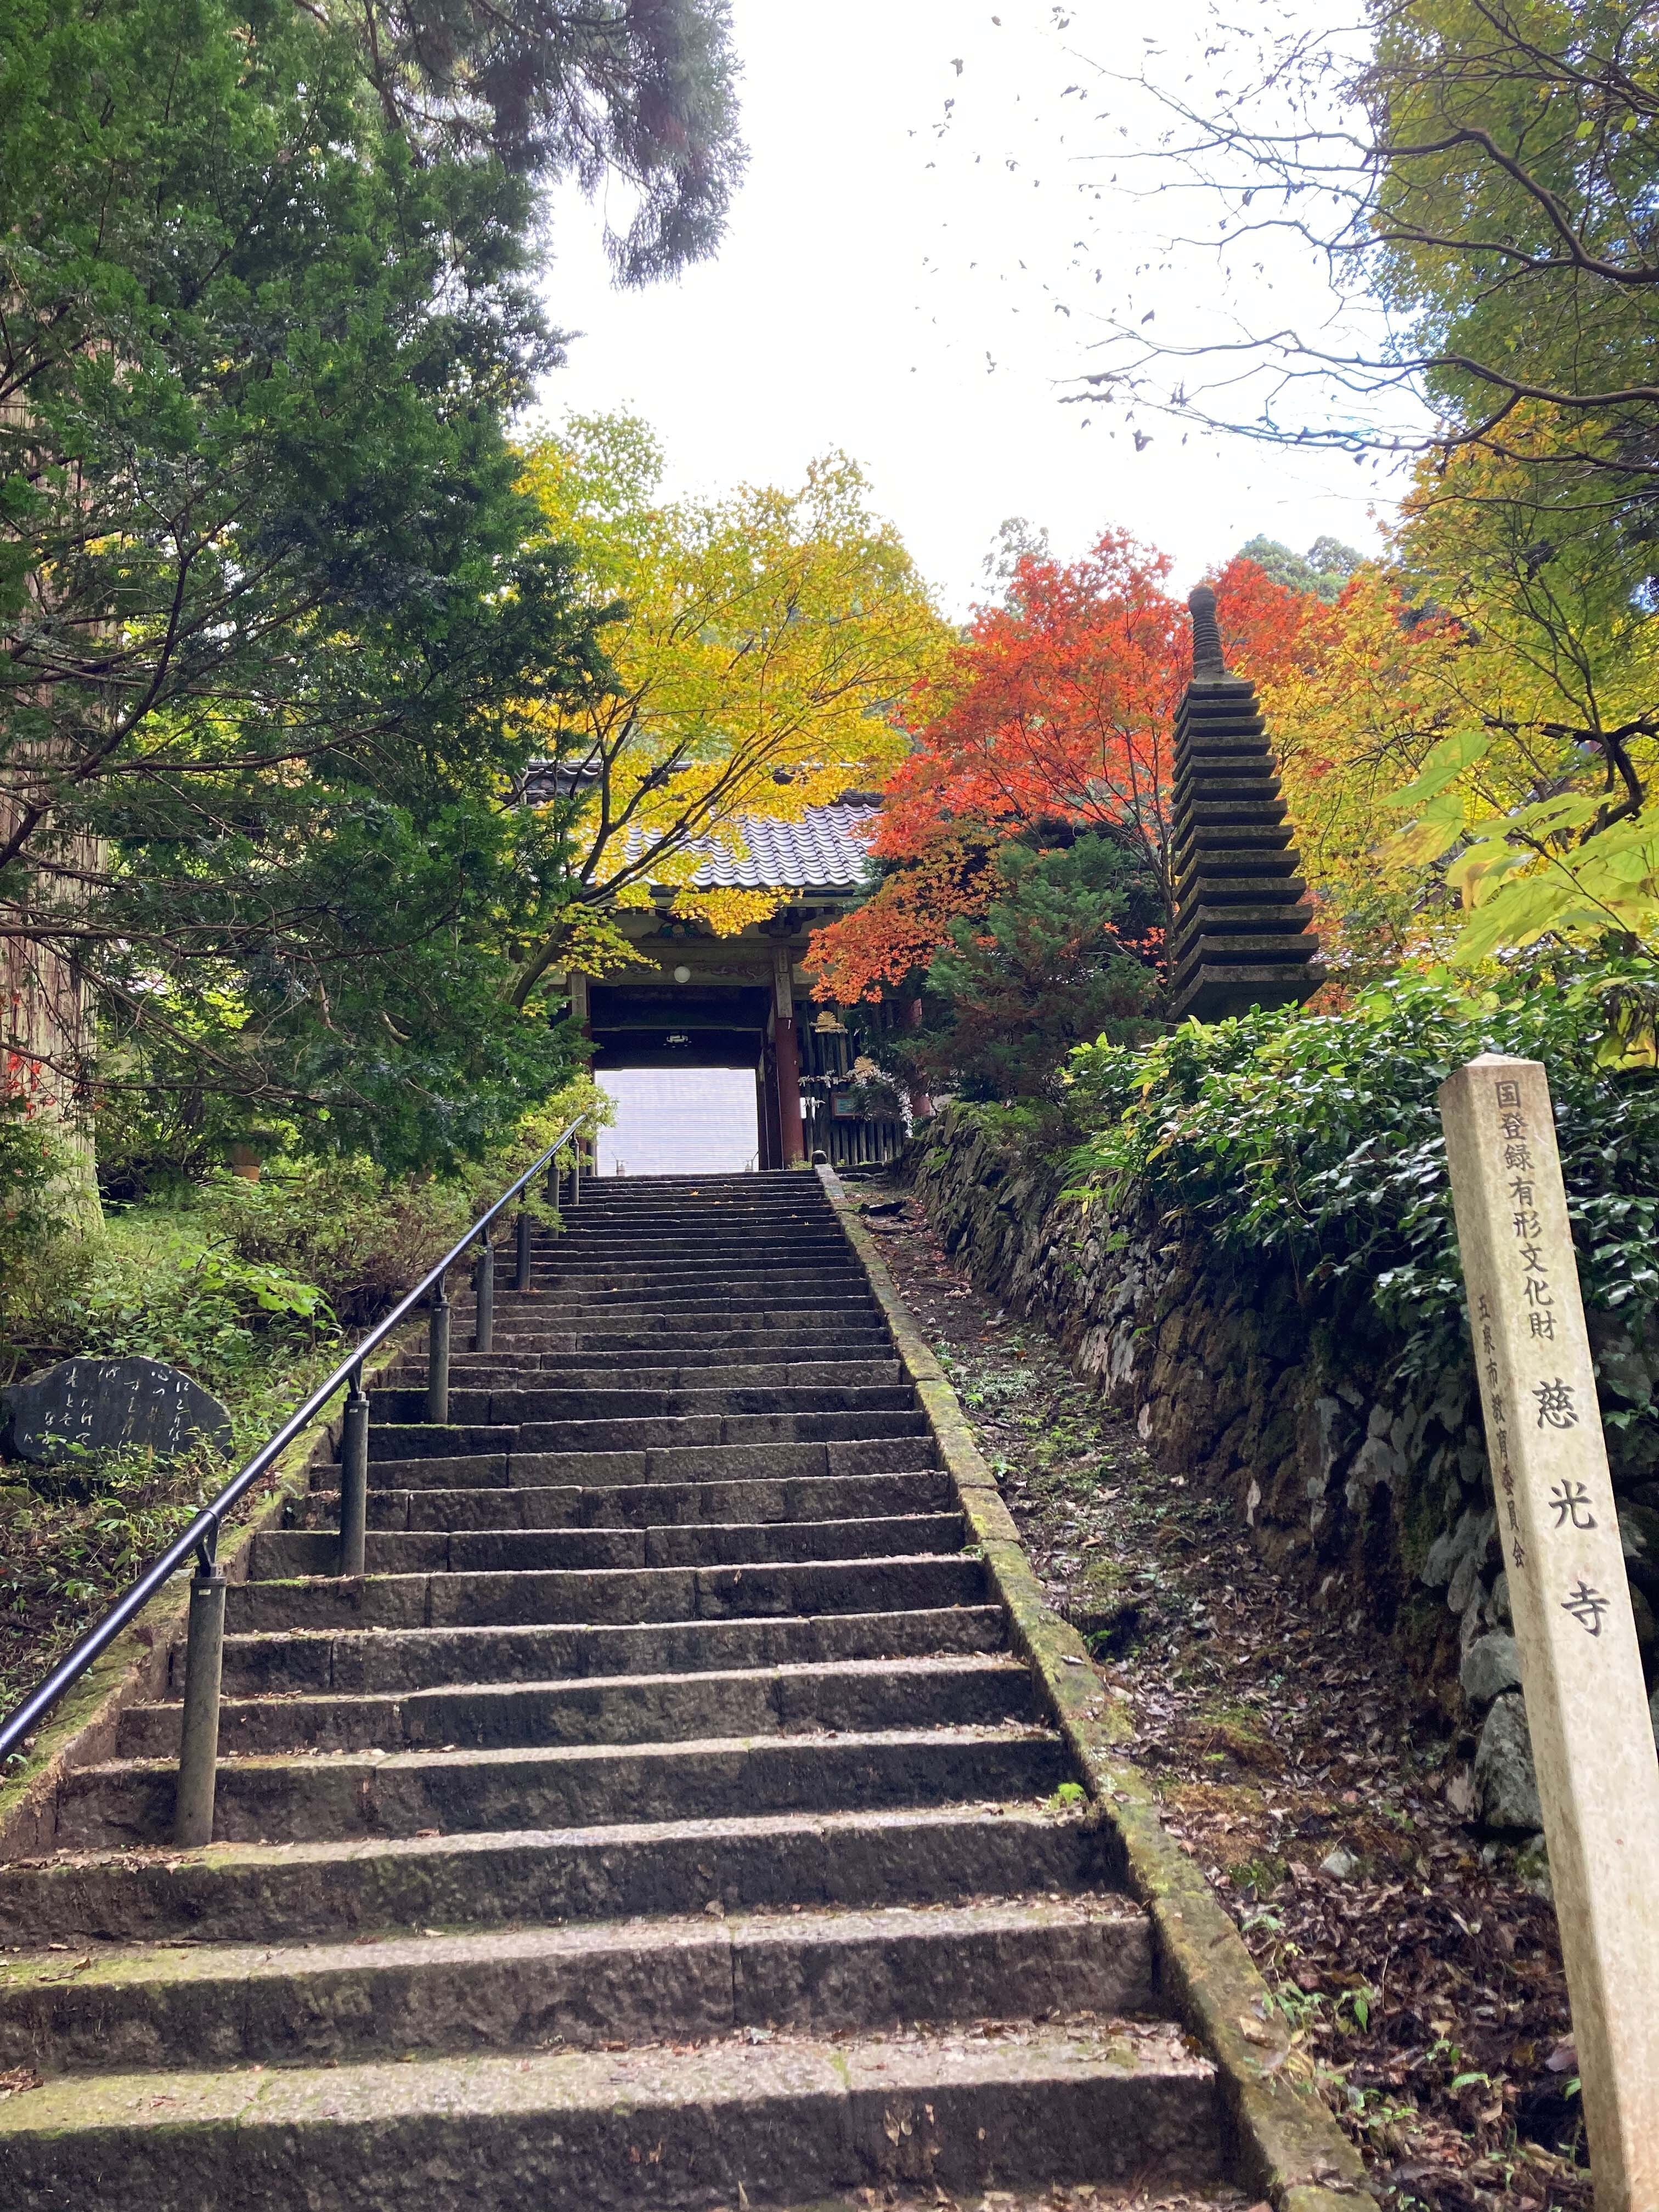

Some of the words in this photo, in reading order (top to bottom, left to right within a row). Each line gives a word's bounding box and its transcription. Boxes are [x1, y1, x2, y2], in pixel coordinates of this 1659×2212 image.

[1494, 1080, 1558, 1341] 国登録有形文化財
[1532, 1376, 1611, 1638] 慈光寺
